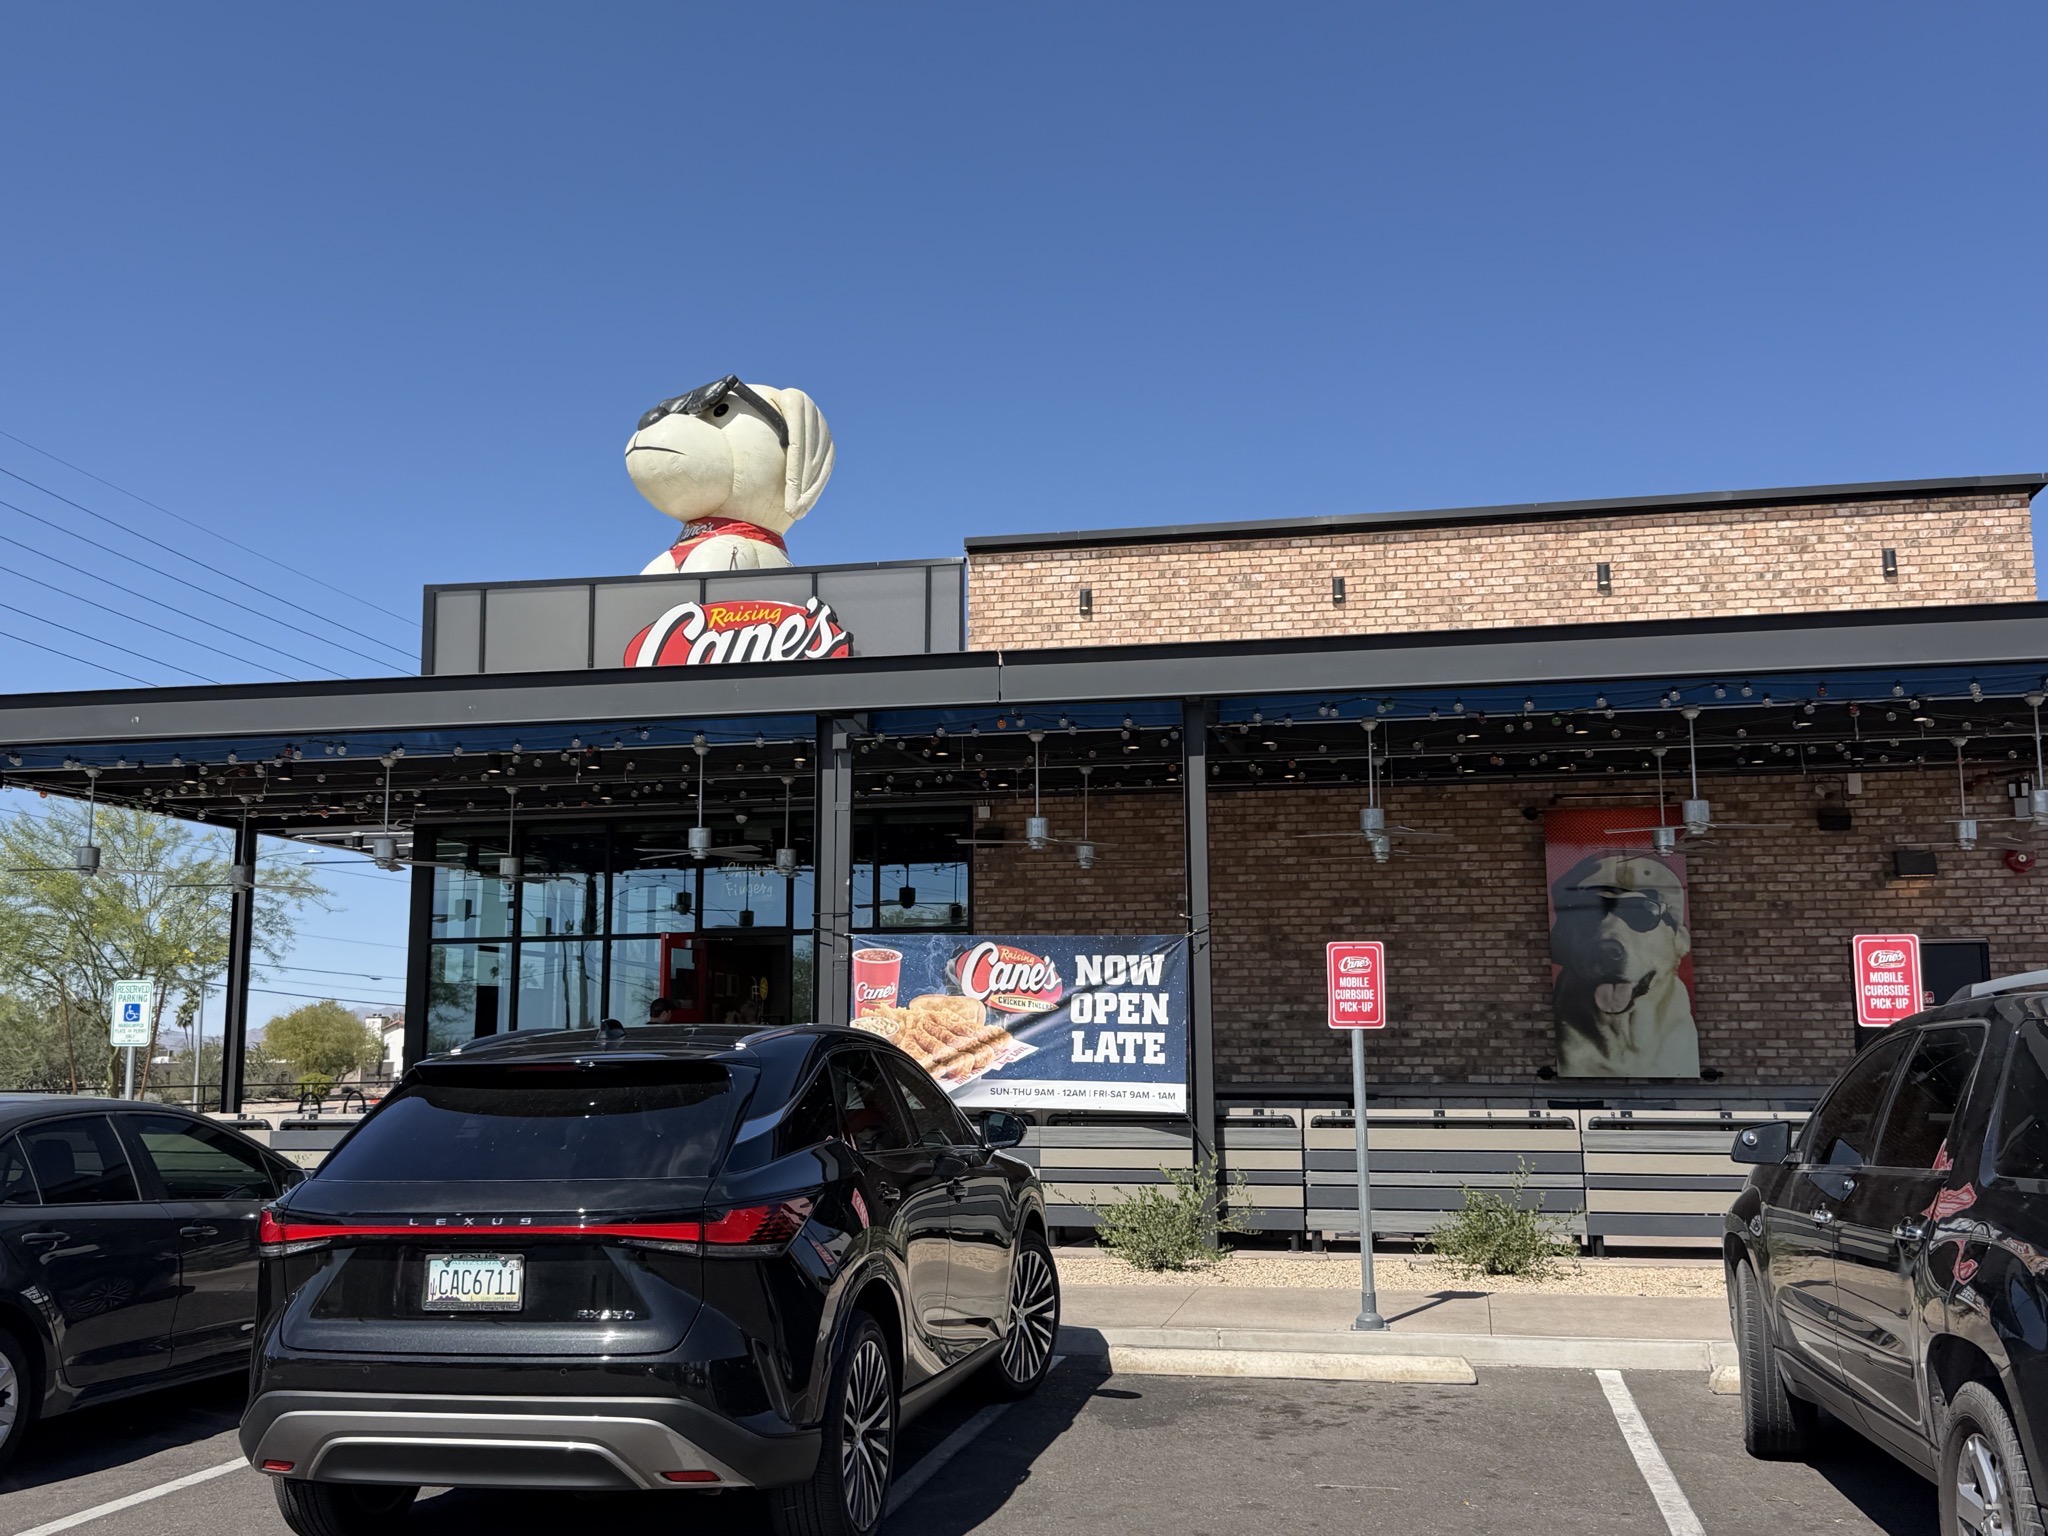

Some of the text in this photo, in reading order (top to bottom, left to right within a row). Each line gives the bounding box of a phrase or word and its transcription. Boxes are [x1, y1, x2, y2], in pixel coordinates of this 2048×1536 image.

[708, 604, 782, 628] Raising
[636, 597, 847, 667] Cane's
[1001, 948, 1035, 965] Raising
[961, 941, 1061, 1001] Cane's
[1075, 954, 1165, 986] NOW
[1339, 977, 1370, 988] MOBILE
[1869, 972, 1904, 983] MOBILE
[117, 985, 151, 993] RESERVED
[856, 981, 896, 1002] Cane's
[1335, 989, 1375, 1000] CURBSIDE
[1864, 985, 1911, 996] CURBSIDE
[118, 994, 148, 1003] PARKING
[1870, 998, 1909, 1009] PICK-UP
[1070, 992, 1169, 1025] OPEN
[1339, 1001, 1373, 1012] PICK-UP
[1071, 1030, 1165, 1064] LATE
[990, 1087, 1032, 1096] SUN-THU
[1034, 1088, 1055, 1096] 9AM
[1063, 1089, 1087, 1097] 12AM
[1094, 1090, 1127, 1098] FRI-SAT
[1130, 1091, 1150, 1099] 9AM
[1158, 1092, 1176, 1100] 1AM
[409, 1217, 532, 1226] LEXUS
[439, 1269, 517, 1295] CAC6711
